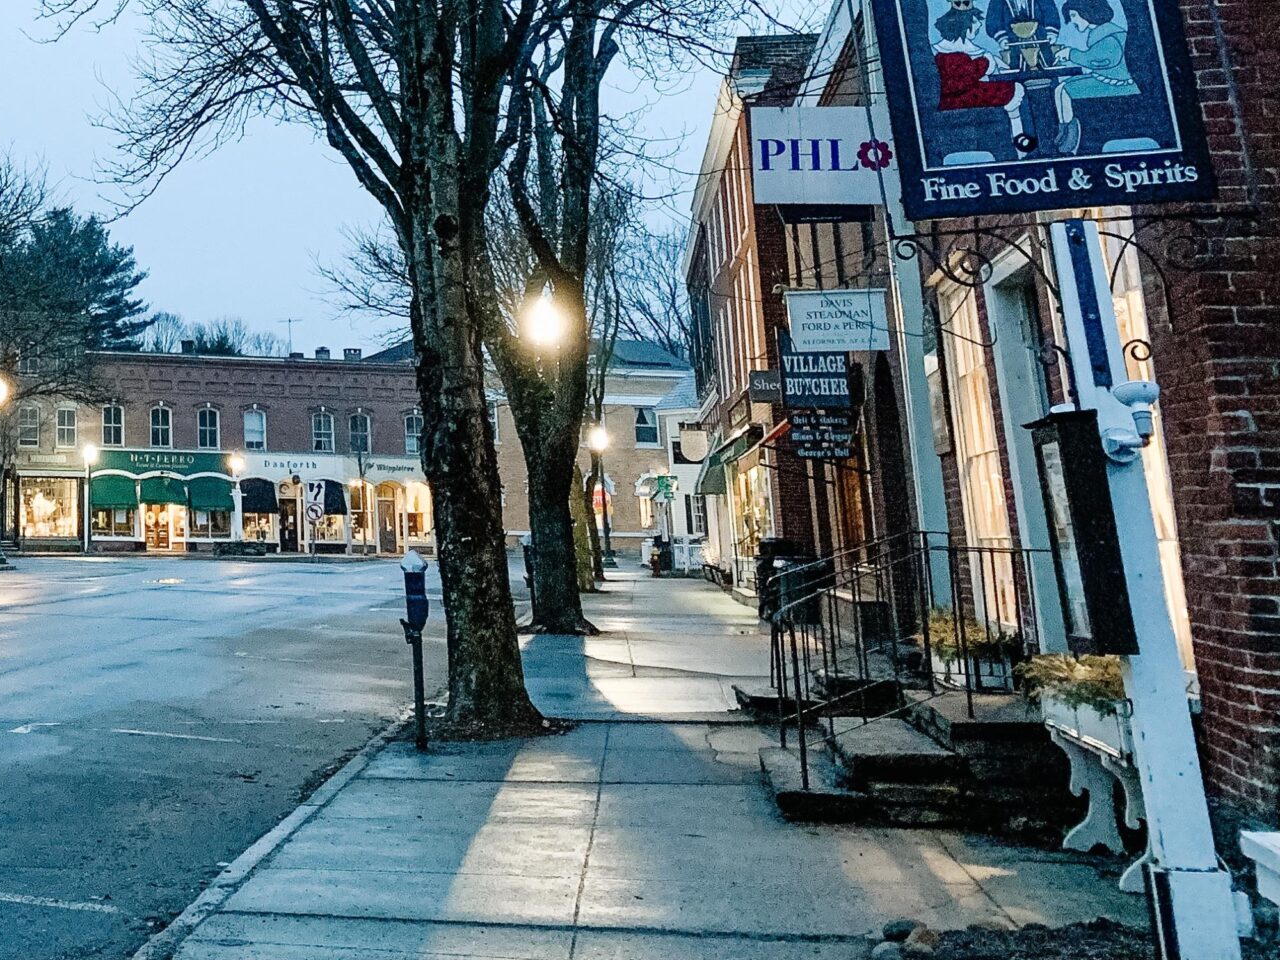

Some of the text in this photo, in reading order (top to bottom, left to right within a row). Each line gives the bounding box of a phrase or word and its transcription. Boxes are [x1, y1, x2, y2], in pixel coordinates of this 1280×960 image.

[920, 160, 1199, 202] Fine Food & Spirits
[820, 298, 853, 308] DAVIS
[806, 309, 869, 320] STEADMAN
[801, 321, 832, 331] FORD
[782, 355, 846, 373] VILLAGE
[785, 377, 849, 396] BUTCHER
[264, 460, 317, 469] Danforth
[376, 463, 416, 473] Whippletree
